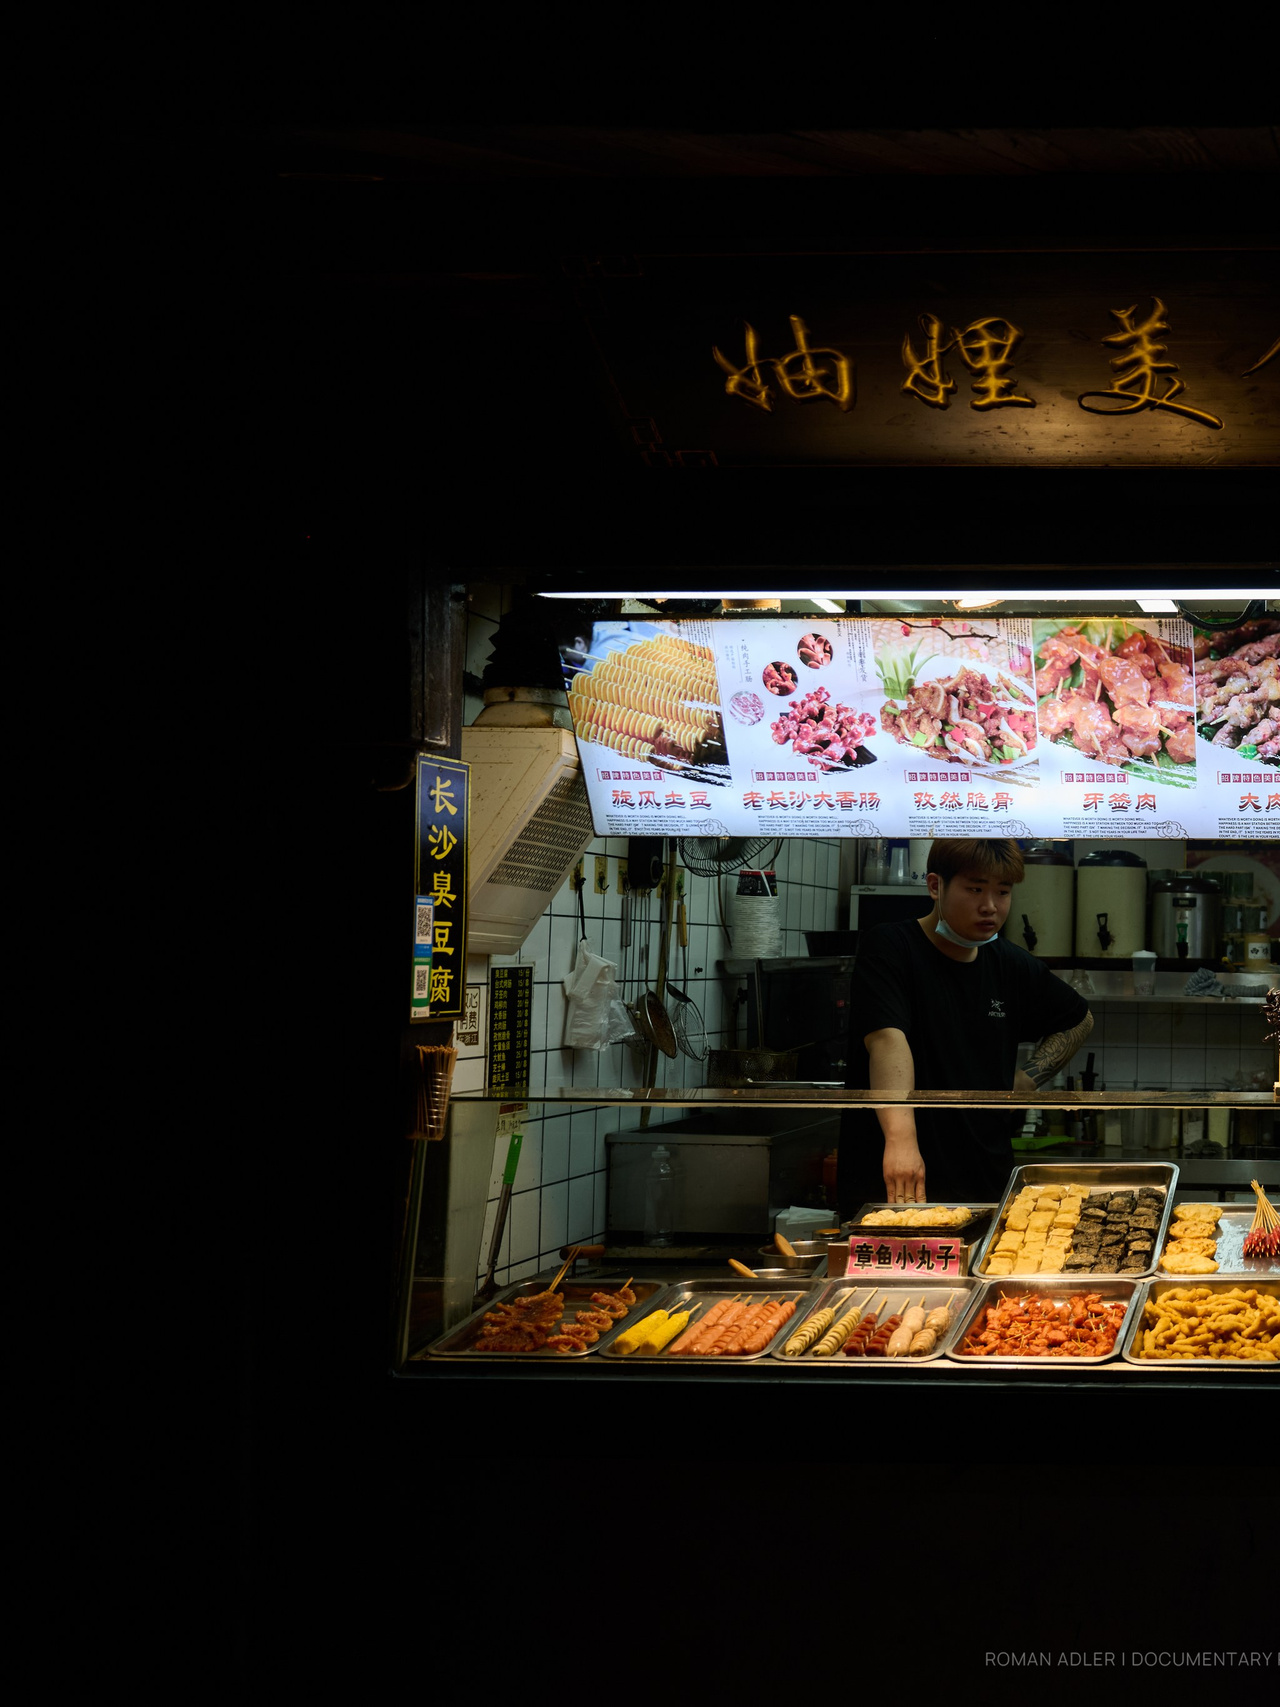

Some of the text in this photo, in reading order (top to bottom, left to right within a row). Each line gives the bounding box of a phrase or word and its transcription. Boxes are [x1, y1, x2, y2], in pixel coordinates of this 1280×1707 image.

[427, 776, 458, 1003] 长沙臭豆腐
[854, 1241, 957, 1272] 章鱼小丸子
